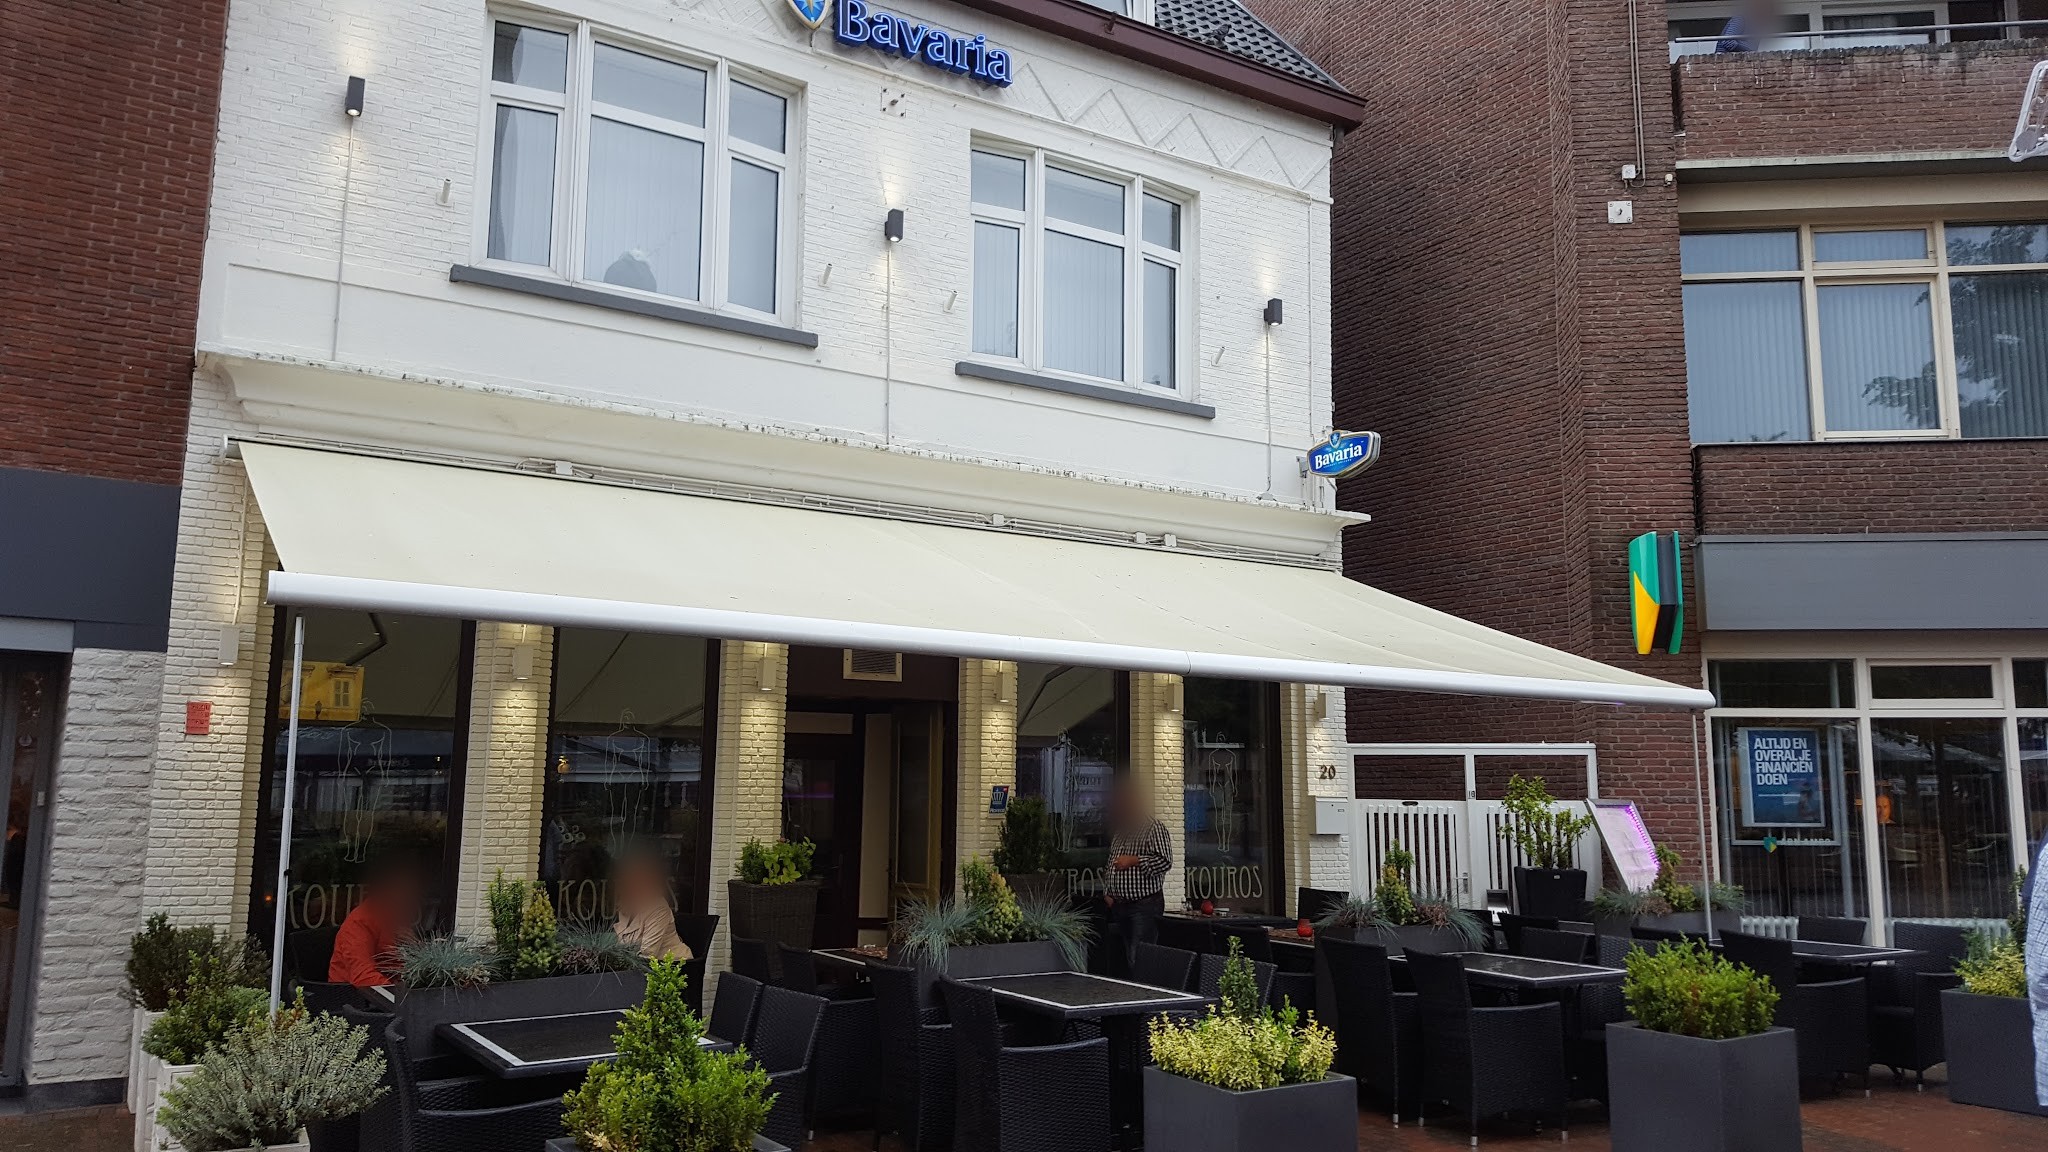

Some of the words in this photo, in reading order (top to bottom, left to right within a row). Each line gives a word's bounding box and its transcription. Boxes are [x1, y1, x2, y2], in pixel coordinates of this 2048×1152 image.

[836, 0, 1013, 87] Bavaria
[1315, 444, 1362, 469] Bavaria
[1754, 738, 1790, 750] ALTIJD
[1793, 738, 1807, 750] EN
[1755, 750, 1798, 761] OVERAL
[1799, 749, 1811, 761] JE
[1319, 764, 1336, 780] 20
[1756, 760, 1813, 773] FINANCIËN
[1757, 774, 1788, 785] DOEN
[1186, 865, 1263, 900] KOUROS
